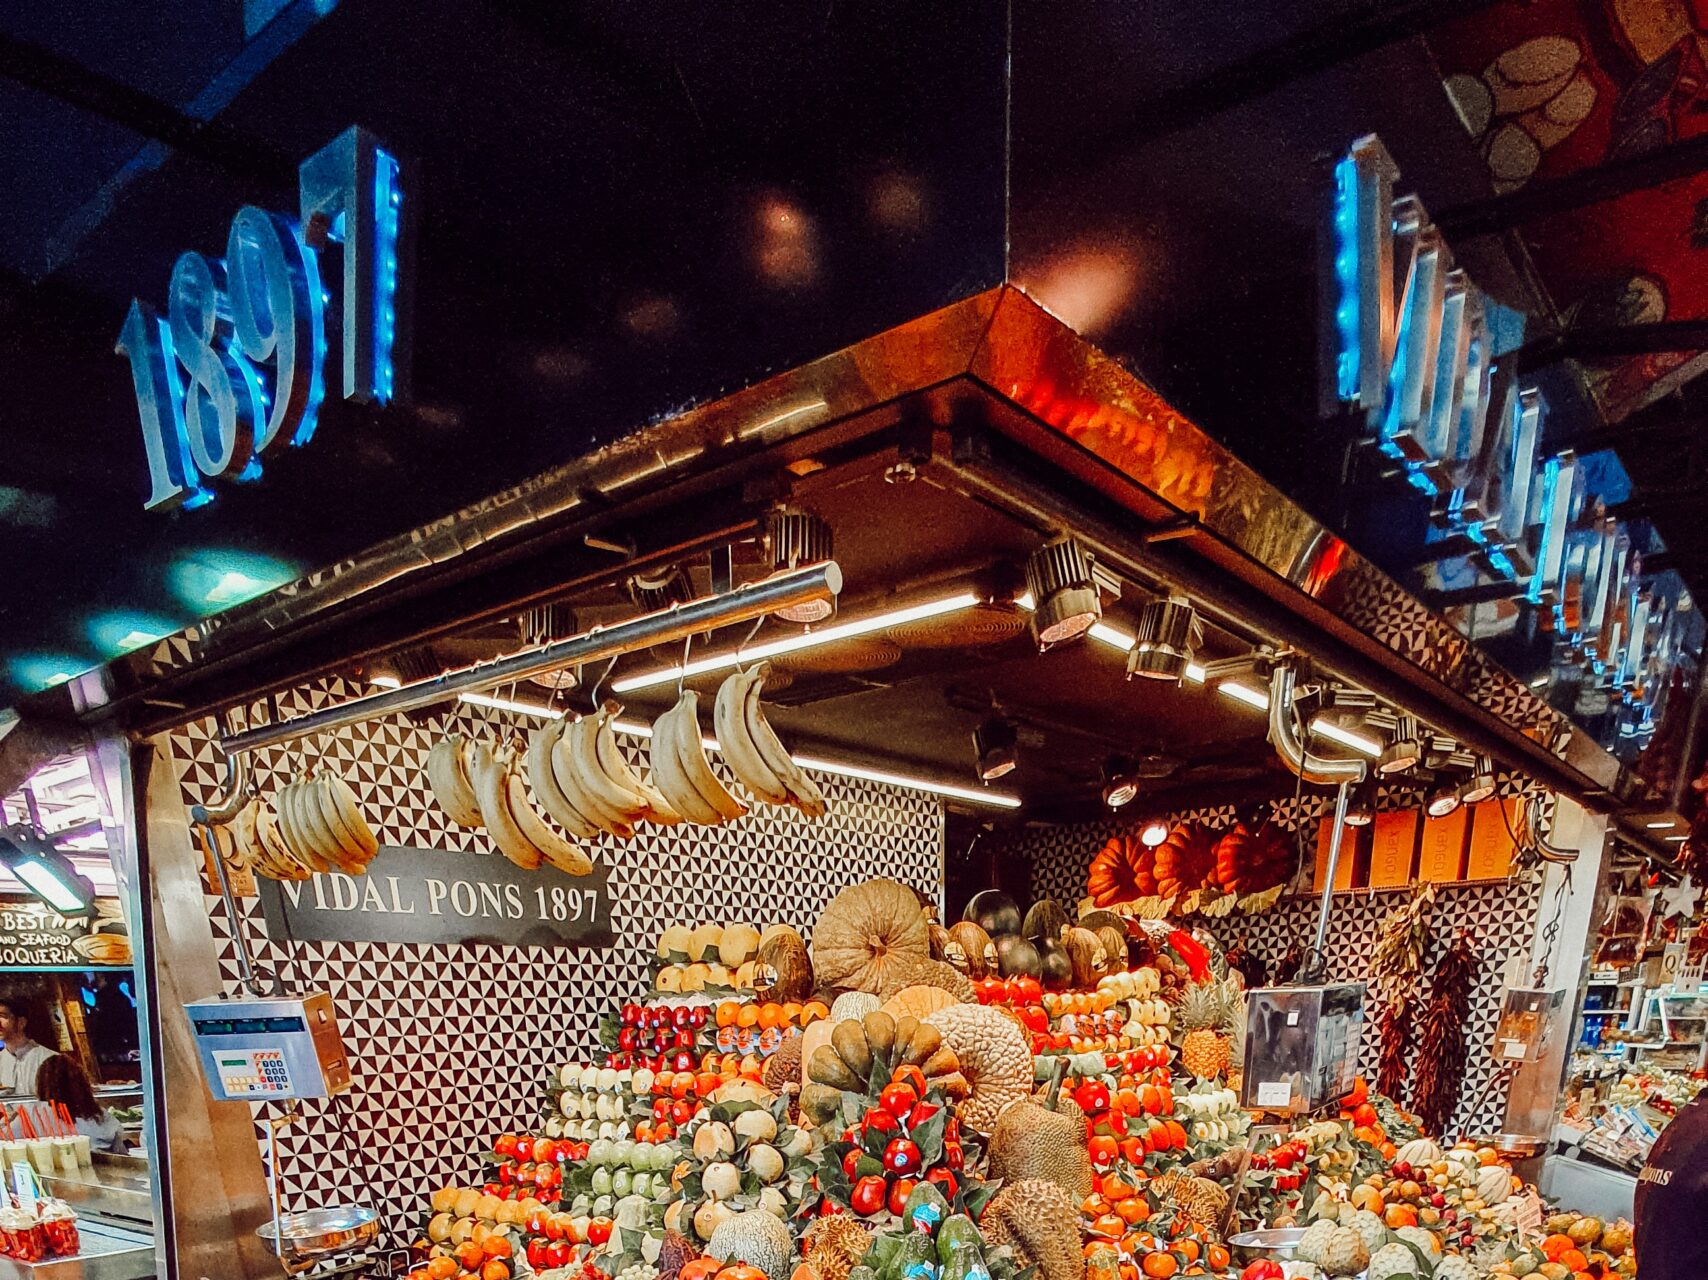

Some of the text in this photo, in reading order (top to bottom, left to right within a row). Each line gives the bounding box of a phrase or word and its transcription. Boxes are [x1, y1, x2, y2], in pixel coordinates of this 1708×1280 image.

[115, 125, 398, 510] 1897
[280, 871, 598, 923] VIDAL PONS 1897
[2, 911, 46, 931] BEST
[19, 933, 71, 946] SEAFOOD
[1665, 954, 1677, 975] Q
